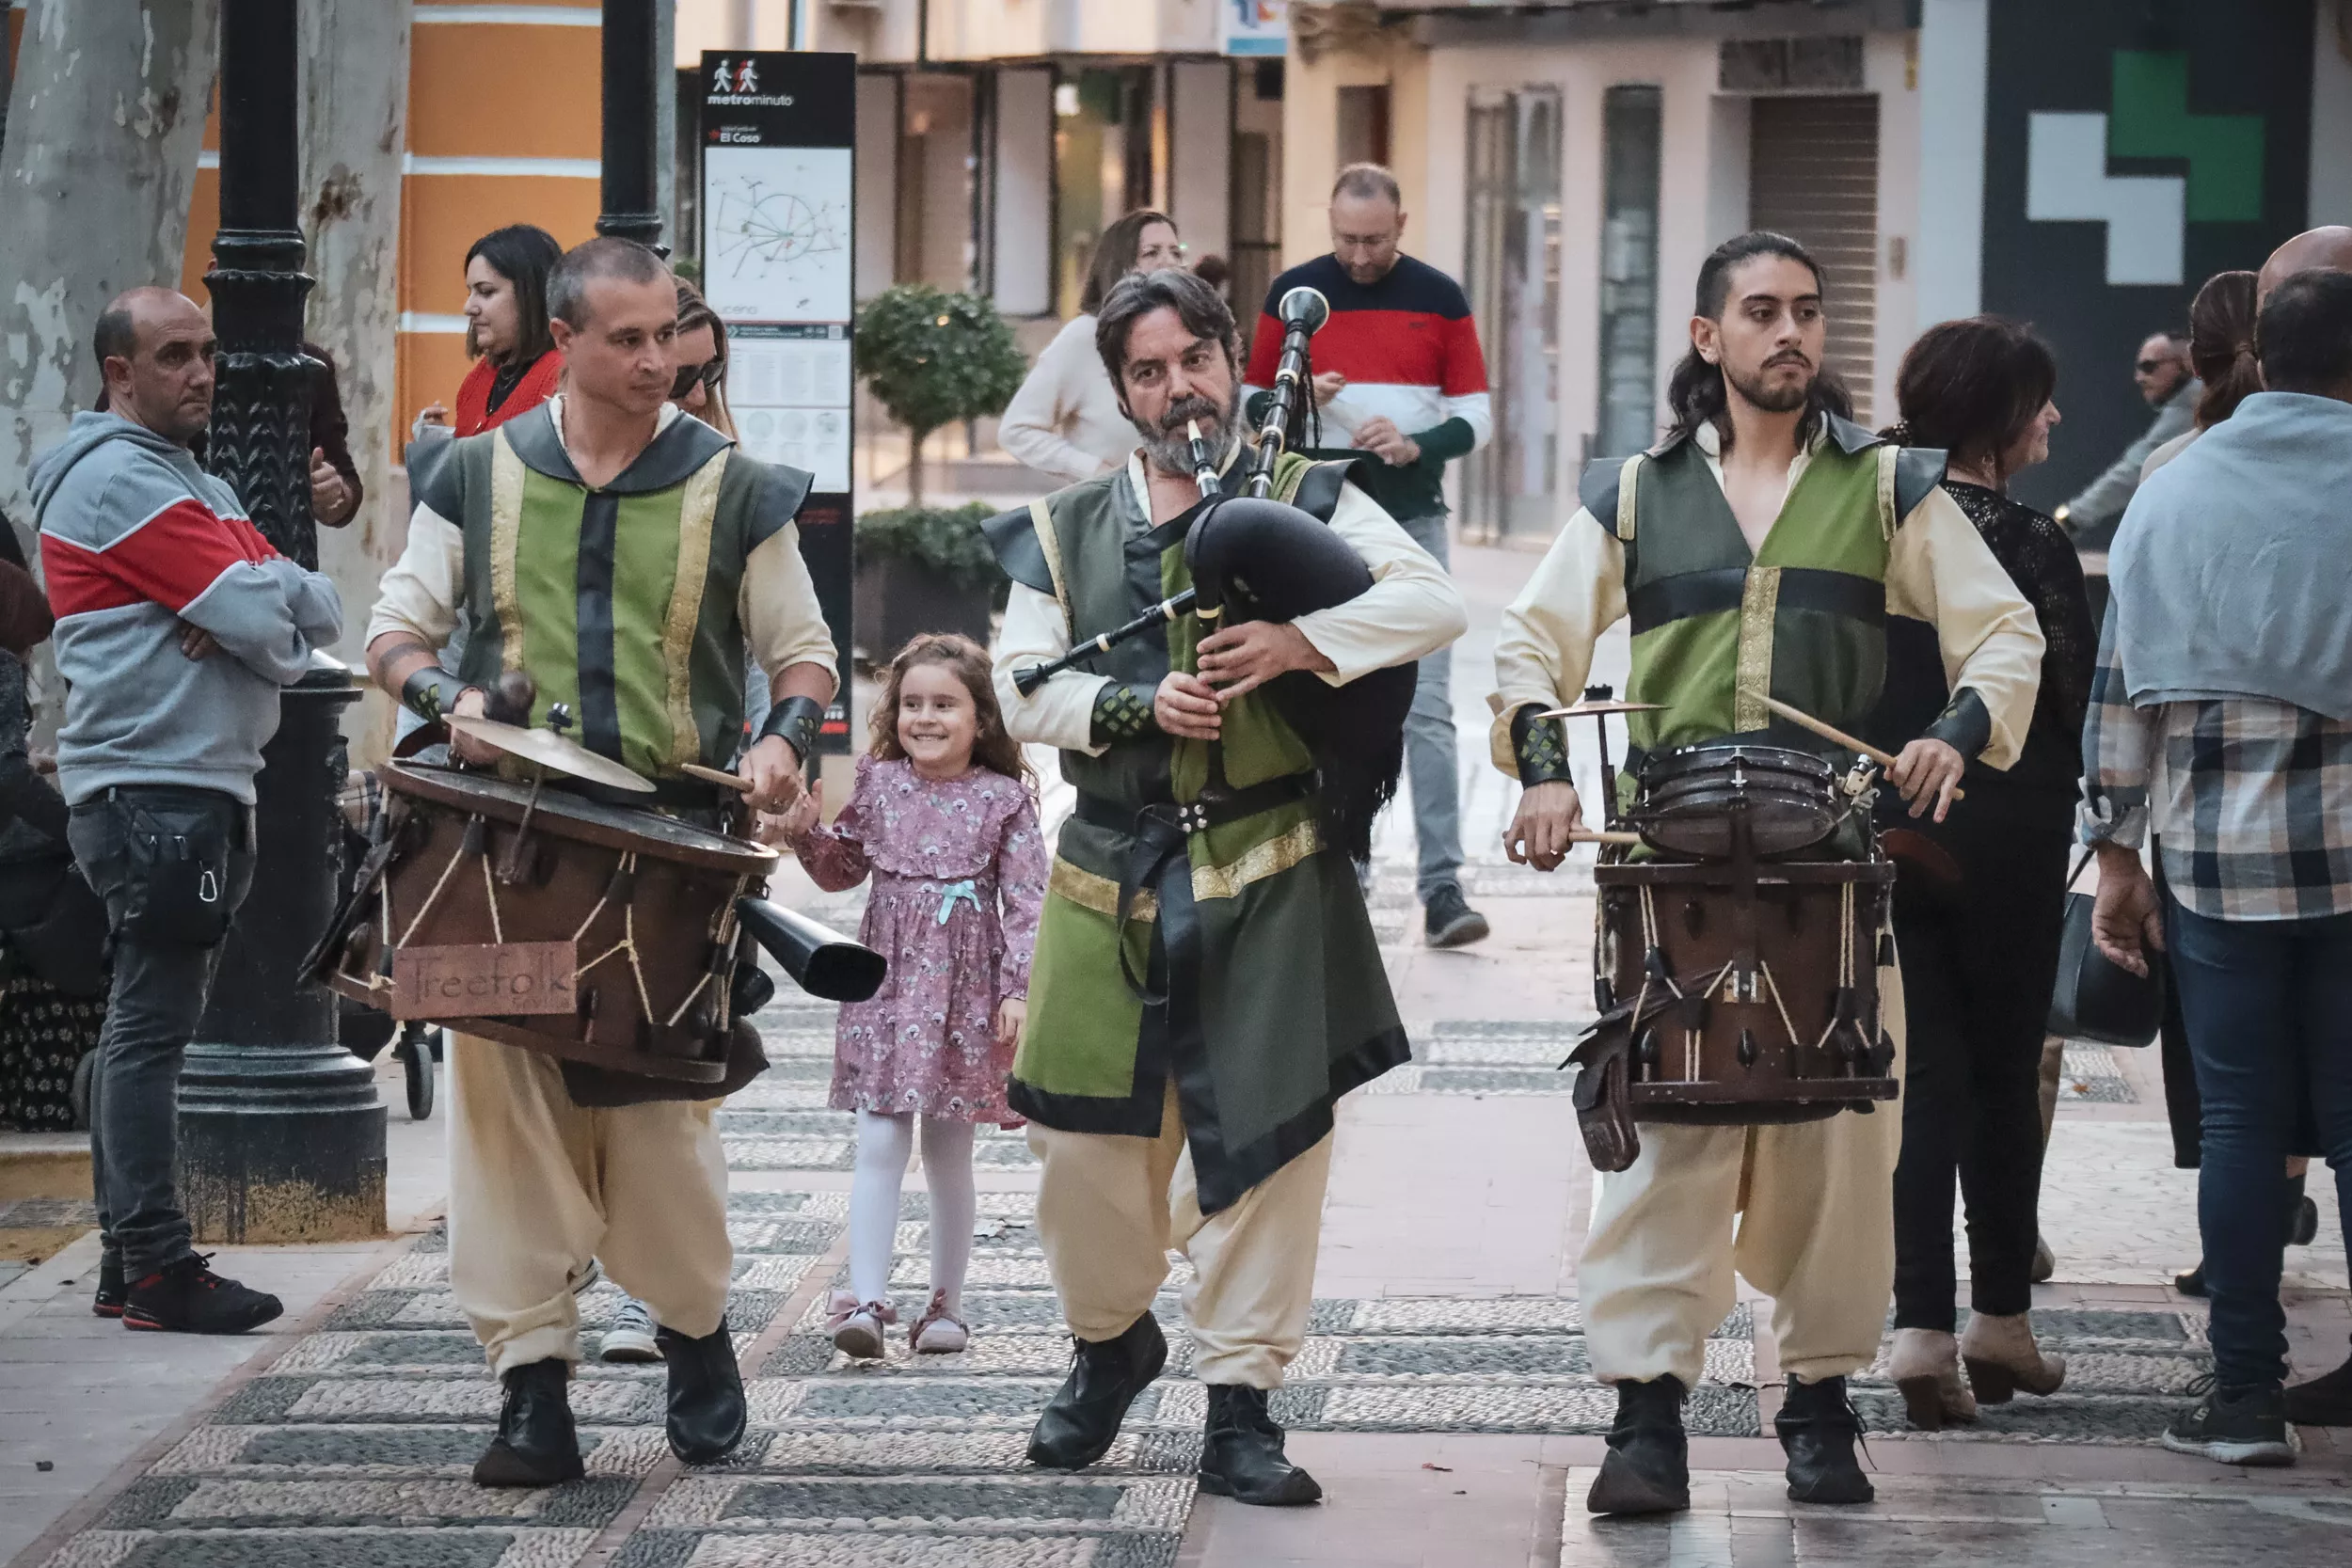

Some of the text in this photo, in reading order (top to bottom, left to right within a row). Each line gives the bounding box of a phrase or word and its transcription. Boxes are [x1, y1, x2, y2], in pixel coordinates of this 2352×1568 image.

[707, 94, 793, 106] metrominuto
[721, 133, 760, 143] El Coso
[396, 950, 573, 1006] Treefolk
